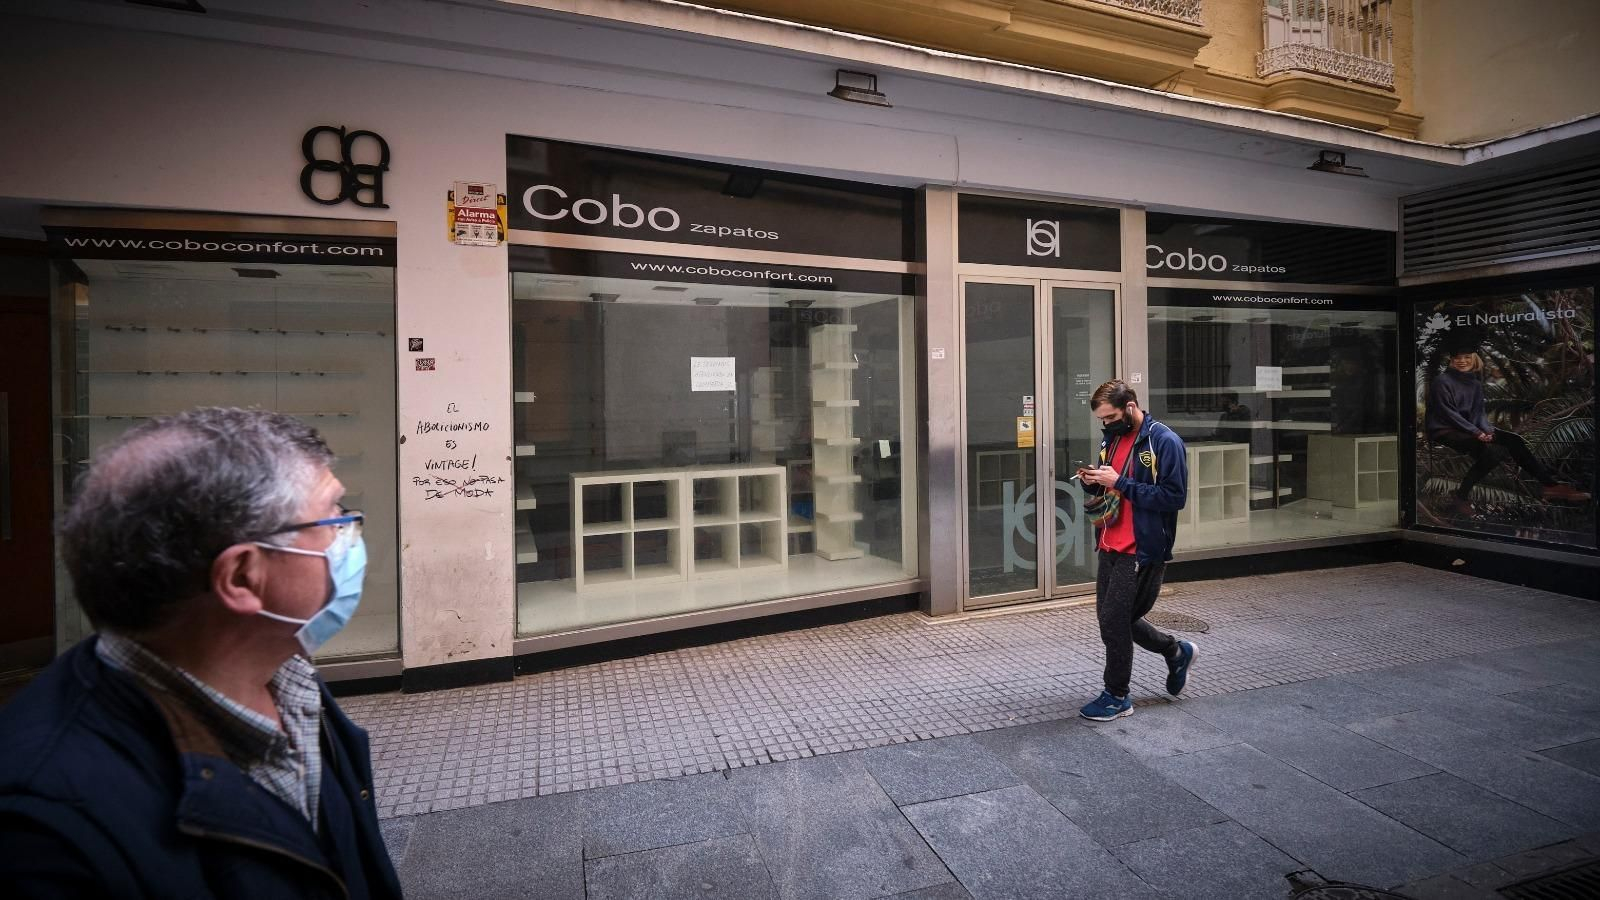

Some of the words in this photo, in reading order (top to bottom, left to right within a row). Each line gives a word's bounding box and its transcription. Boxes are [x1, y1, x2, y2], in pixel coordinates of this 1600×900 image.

[457, 209, 495, 218] Alarma
[522, 184, 681, 233] Cobo
[690, 222, 779, 241] zapatos
[64, 238, 384, 257] www.coboconfort.com
[1146, 244, 1228, 272] Cobo
[1232, 264, 1286, 274] zapatos
[630, 262, 834, 284] www.coboconfort.com
[1212, 294, 1334, 305] www.coboconfort.com
[1456, 315, 1472, 327] El
[1475, 308, 1576, 325] Naturalista
[446, 402, 460, 414] EL
[416, 420, 490, 435] ABOLICIONISMO
[445, 439, 457, 450] ES
[424, 453, 477, 472] VINTAGE!
[412, 476, 431, 487] POR
